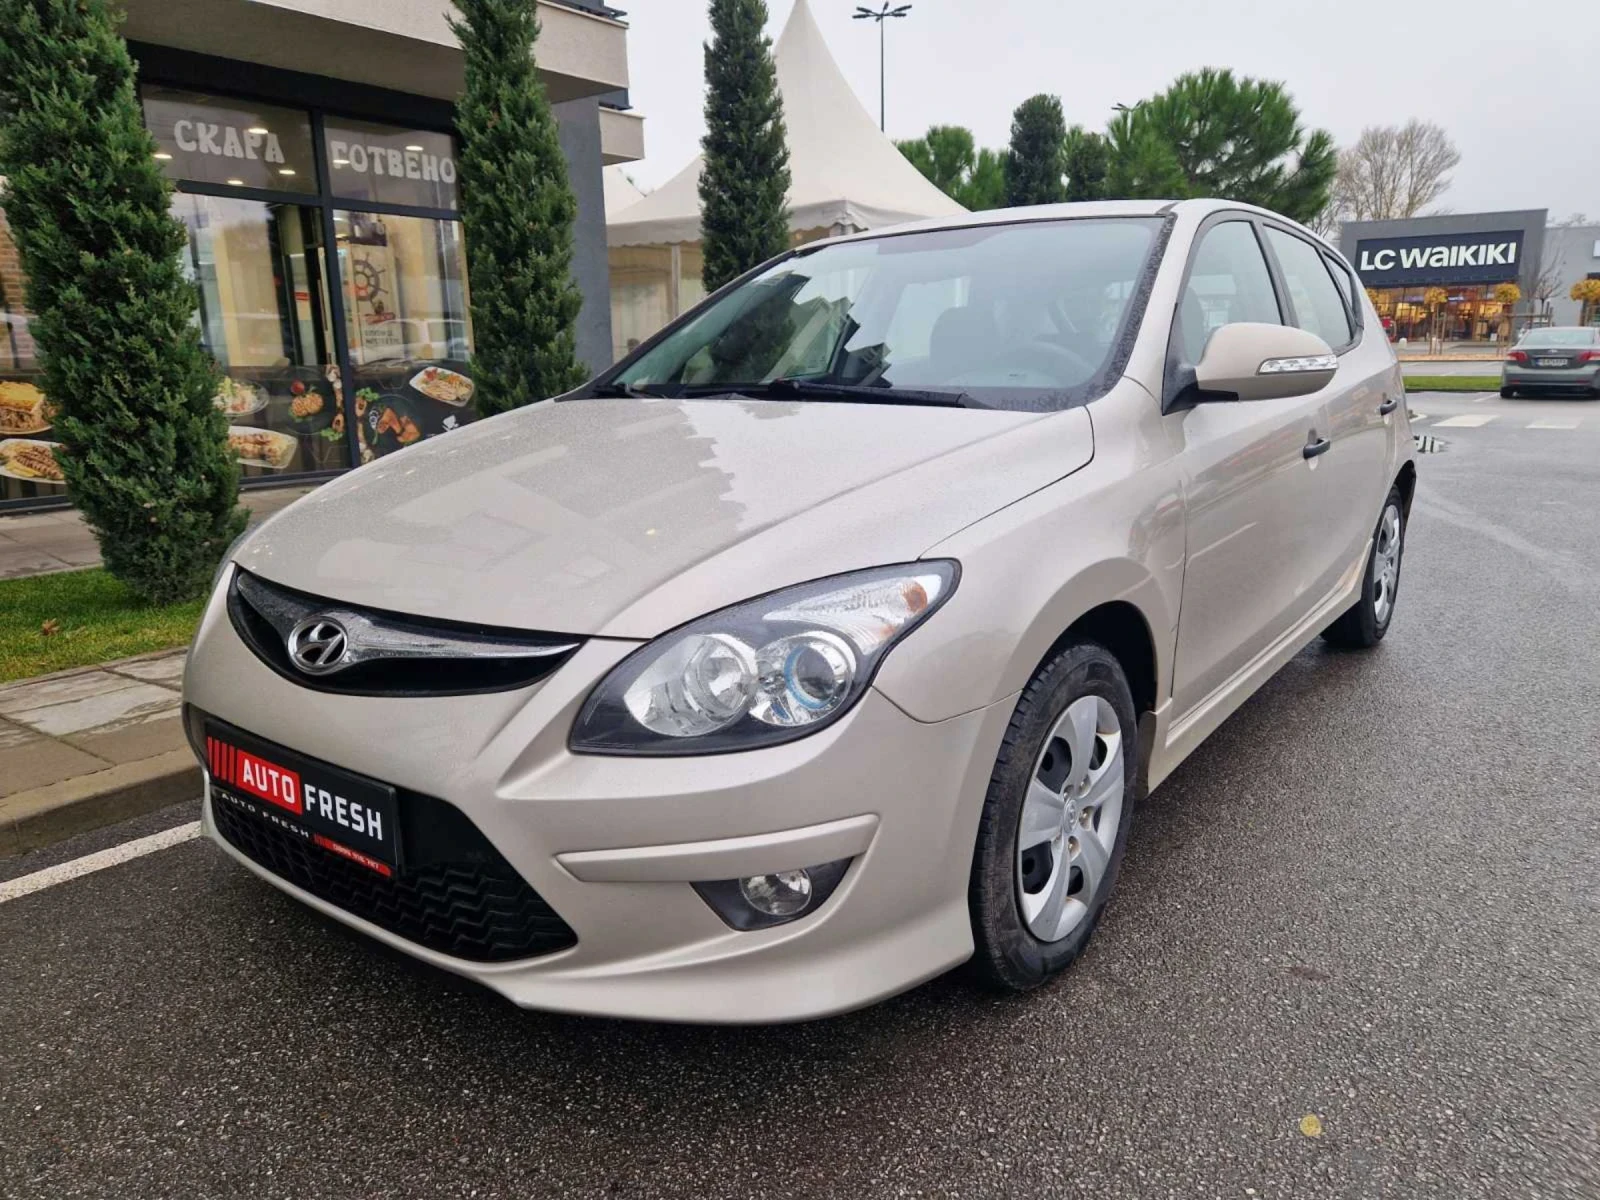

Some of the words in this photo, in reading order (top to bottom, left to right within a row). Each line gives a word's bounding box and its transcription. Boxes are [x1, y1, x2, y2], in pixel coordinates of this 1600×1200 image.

[174, 120, 285, 164] СКАРА
[330, 140, 457, 184] ГОТВЕНО
[1360, 249, 1396, 271] LC
[221, 792, 256, 813] AUTO
[262, 811, 309, 838] FRESH
[243, 759, 295, 804] AUTO
[304, 784, 383, 841] FRESH
